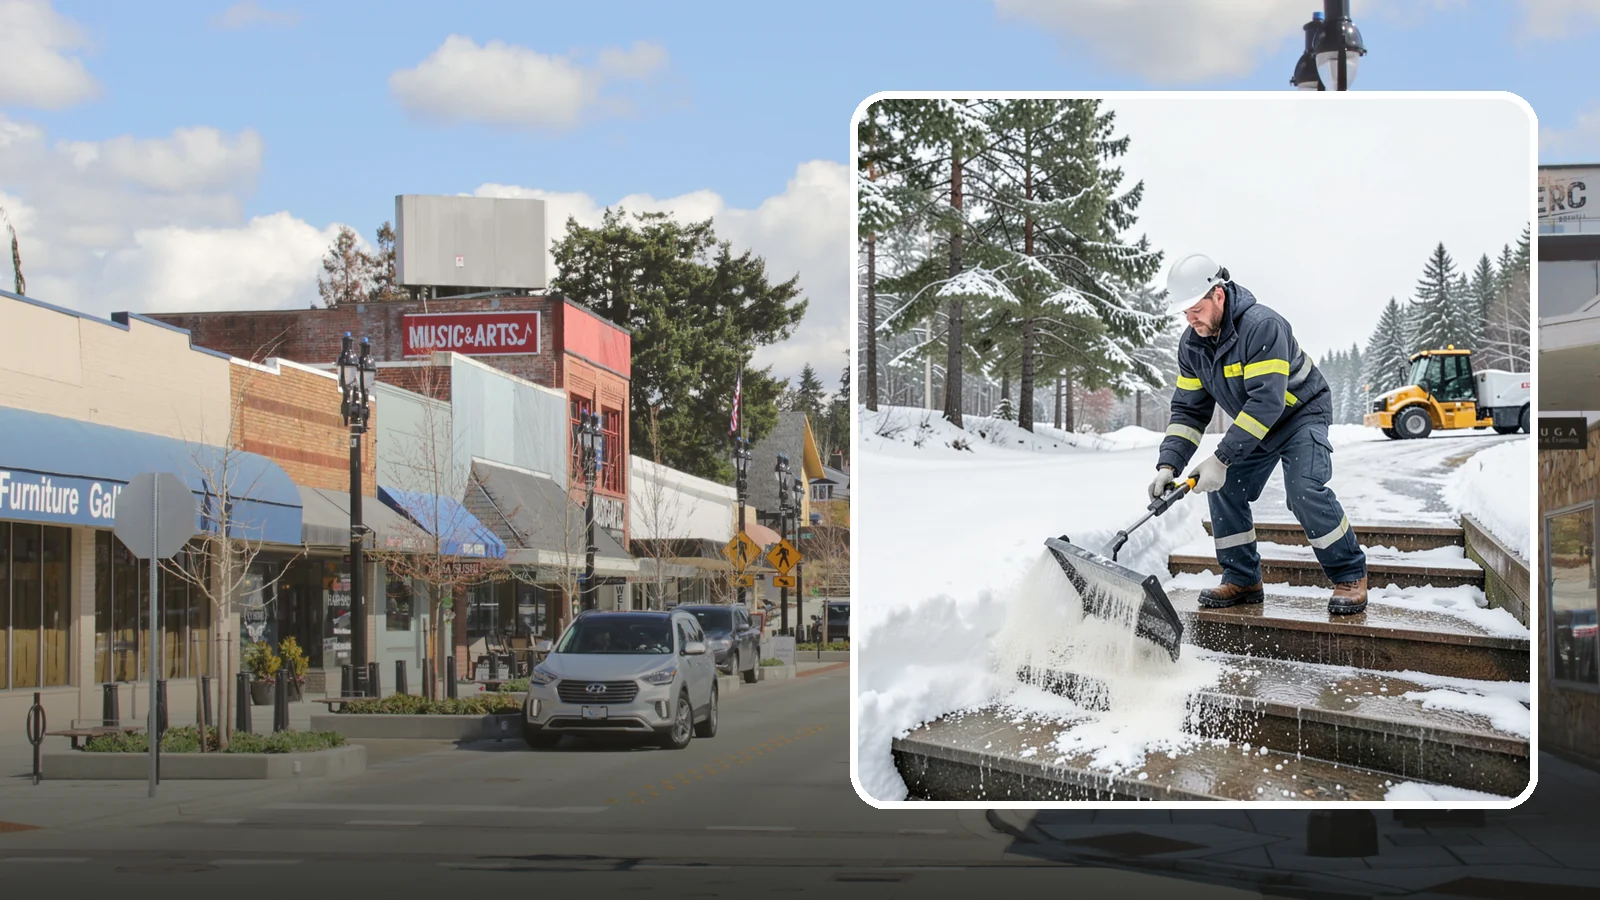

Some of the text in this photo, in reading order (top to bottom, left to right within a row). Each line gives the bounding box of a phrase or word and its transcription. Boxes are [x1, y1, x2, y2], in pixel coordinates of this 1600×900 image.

[0, 472, 121, 519] Furniture Gal
[453, 563, 479, 574] SUSHI
